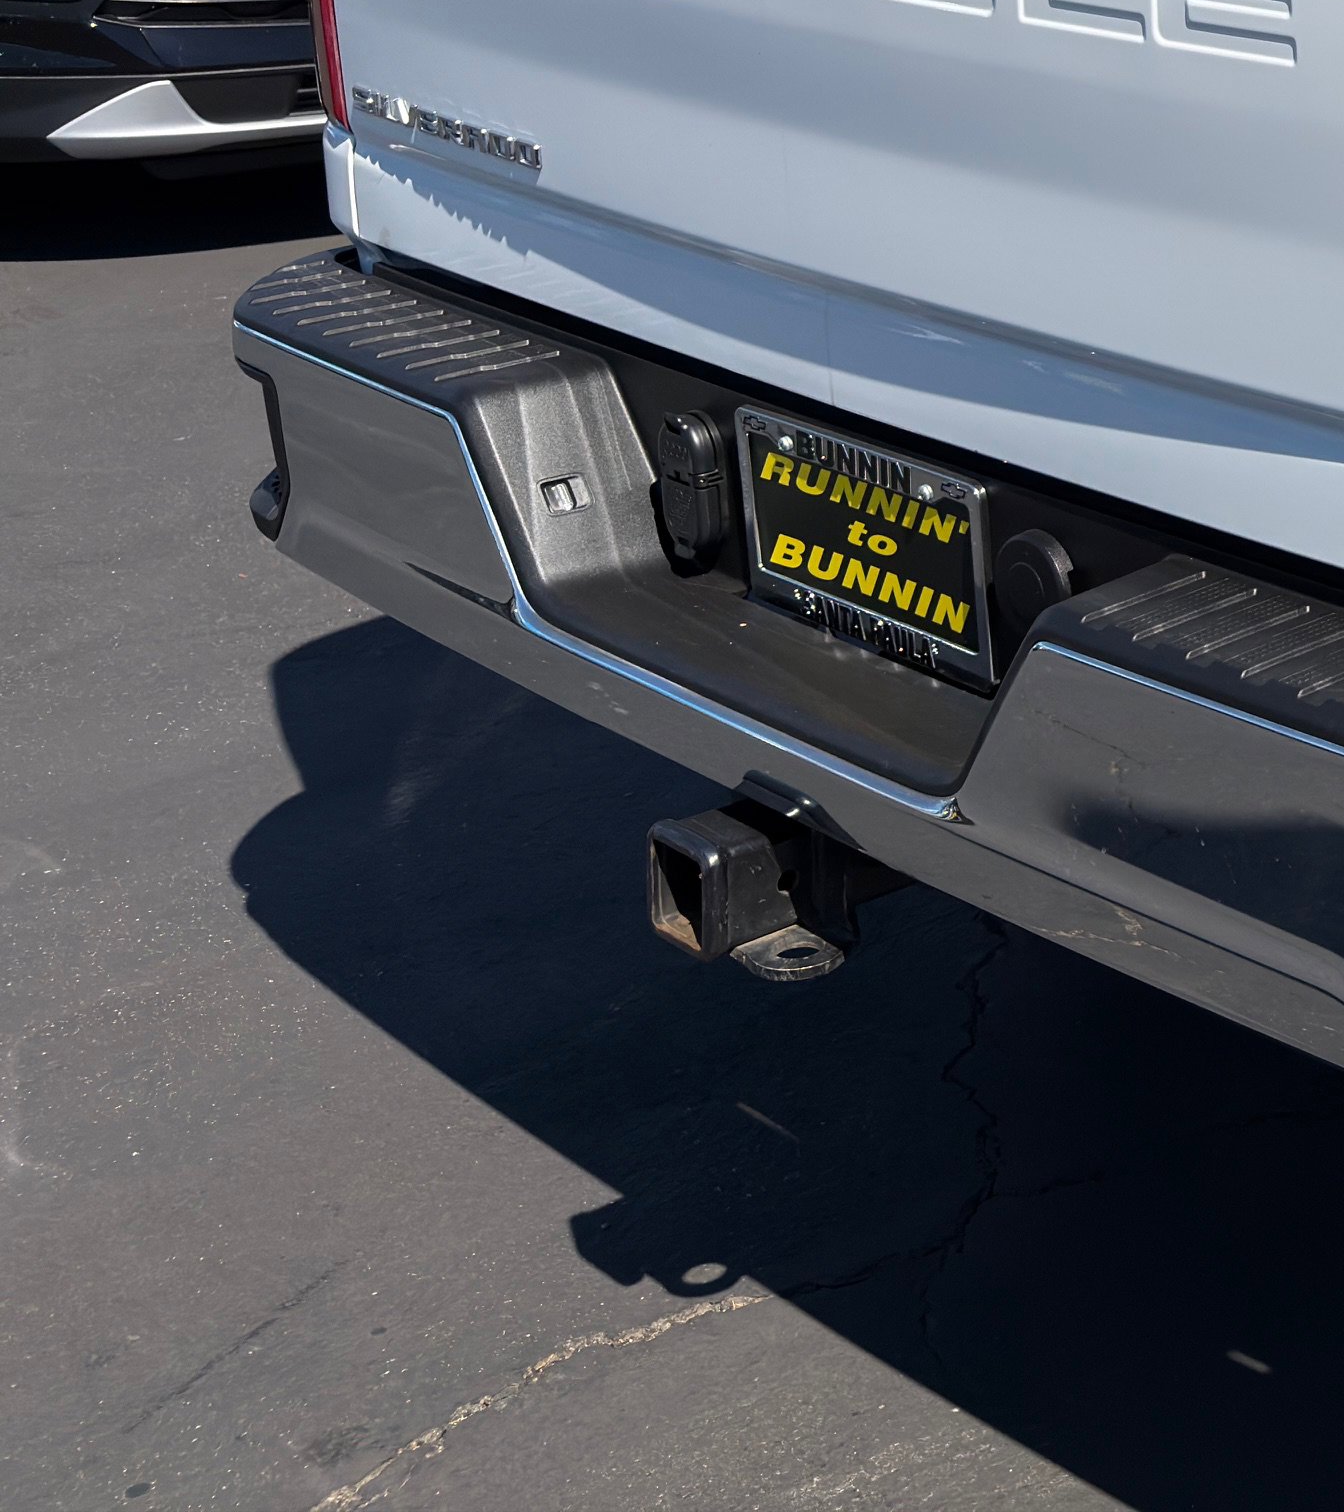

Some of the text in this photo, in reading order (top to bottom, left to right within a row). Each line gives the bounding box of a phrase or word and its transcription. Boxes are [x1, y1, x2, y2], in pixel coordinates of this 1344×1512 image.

[352, 85, 543, 169] SILVERADO
[760, 451, 971, 544] RUNNIN'
[796, 429, 912, 496] BUNNIN
[846, 520, 898, 557] to
[769, 533, 971, 635] BUNNIN
